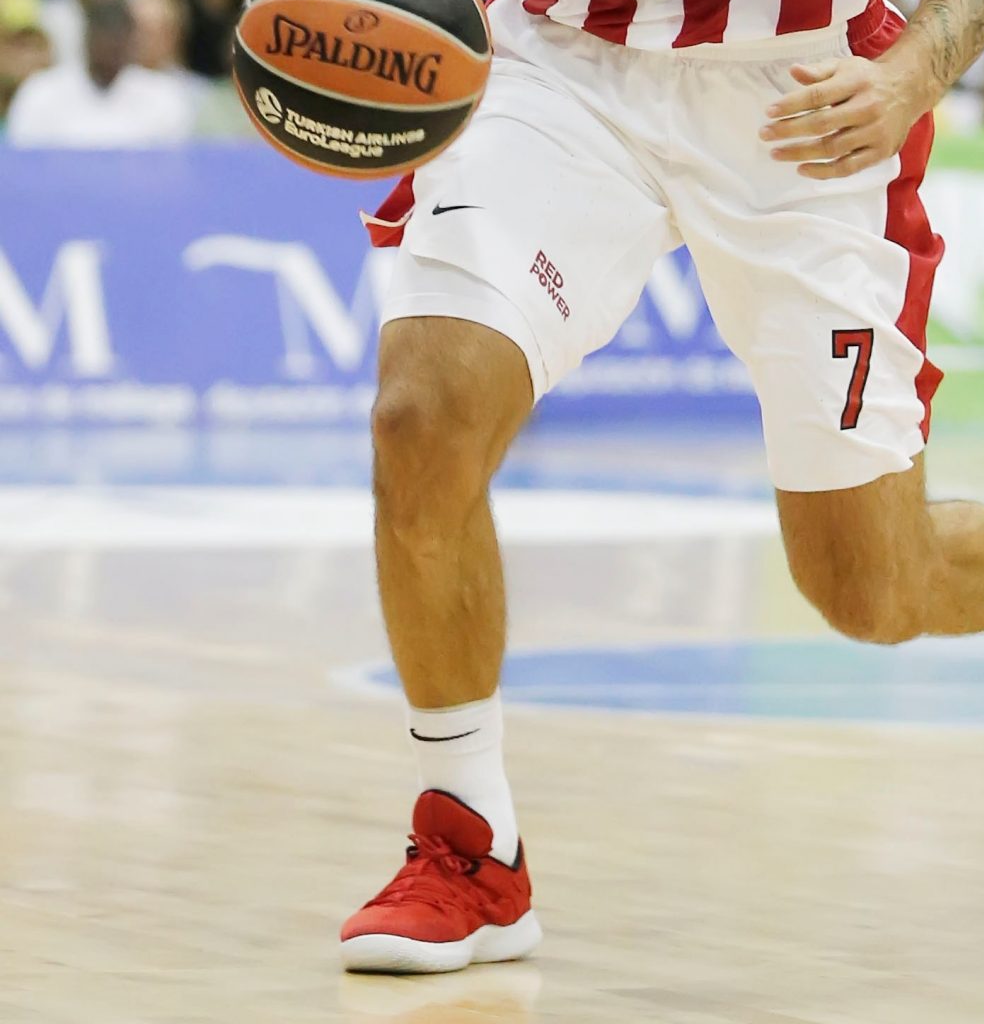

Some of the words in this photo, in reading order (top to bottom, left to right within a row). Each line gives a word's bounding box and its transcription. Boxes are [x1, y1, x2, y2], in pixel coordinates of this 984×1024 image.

[265, 14, 443, 95] SPALDING
[285, 107, 354, 144] TURKISH
[354, 128, 426, 147] AIRLINES
[529, 263, 570, 322] POWER
[535, 249, 564, 289] RED
[831, 327, 874, 431] 7
